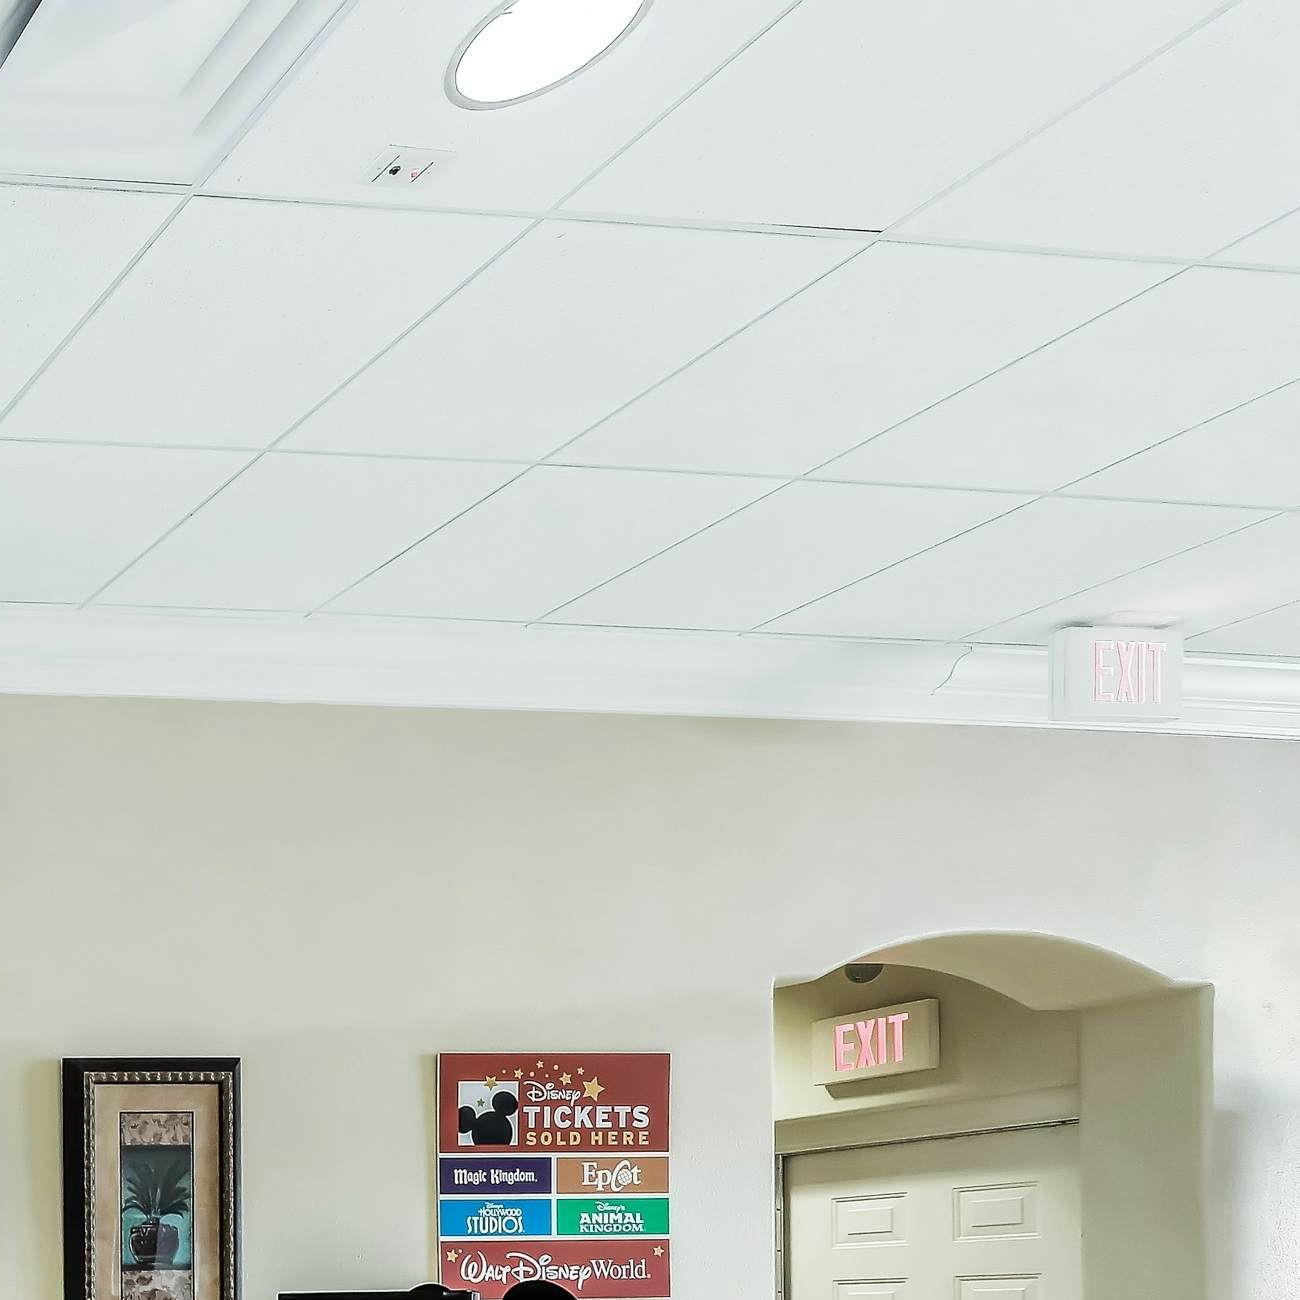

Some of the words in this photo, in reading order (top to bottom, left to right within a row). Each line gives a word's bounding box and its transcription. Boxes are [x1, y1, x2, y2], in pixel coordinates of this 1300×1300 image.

[1094, 640, 1167, 704] EXIT
[834, 1013, 909, 1072] EXIT
[523, 1081, 581, 1106] Disney
[523, 1106, 650, 1129] TICKETS
[526, 1132, 581, 1145] SOLD
[591, 1131, 650, 1145] HERE
[454, 1169, 487, 1185] Magic
[579, 1213, 644, 1224] ANIMAL
[579, 1224, 644, 1233] KINGDOM
[506, 1251, 592, 1290] Disney
